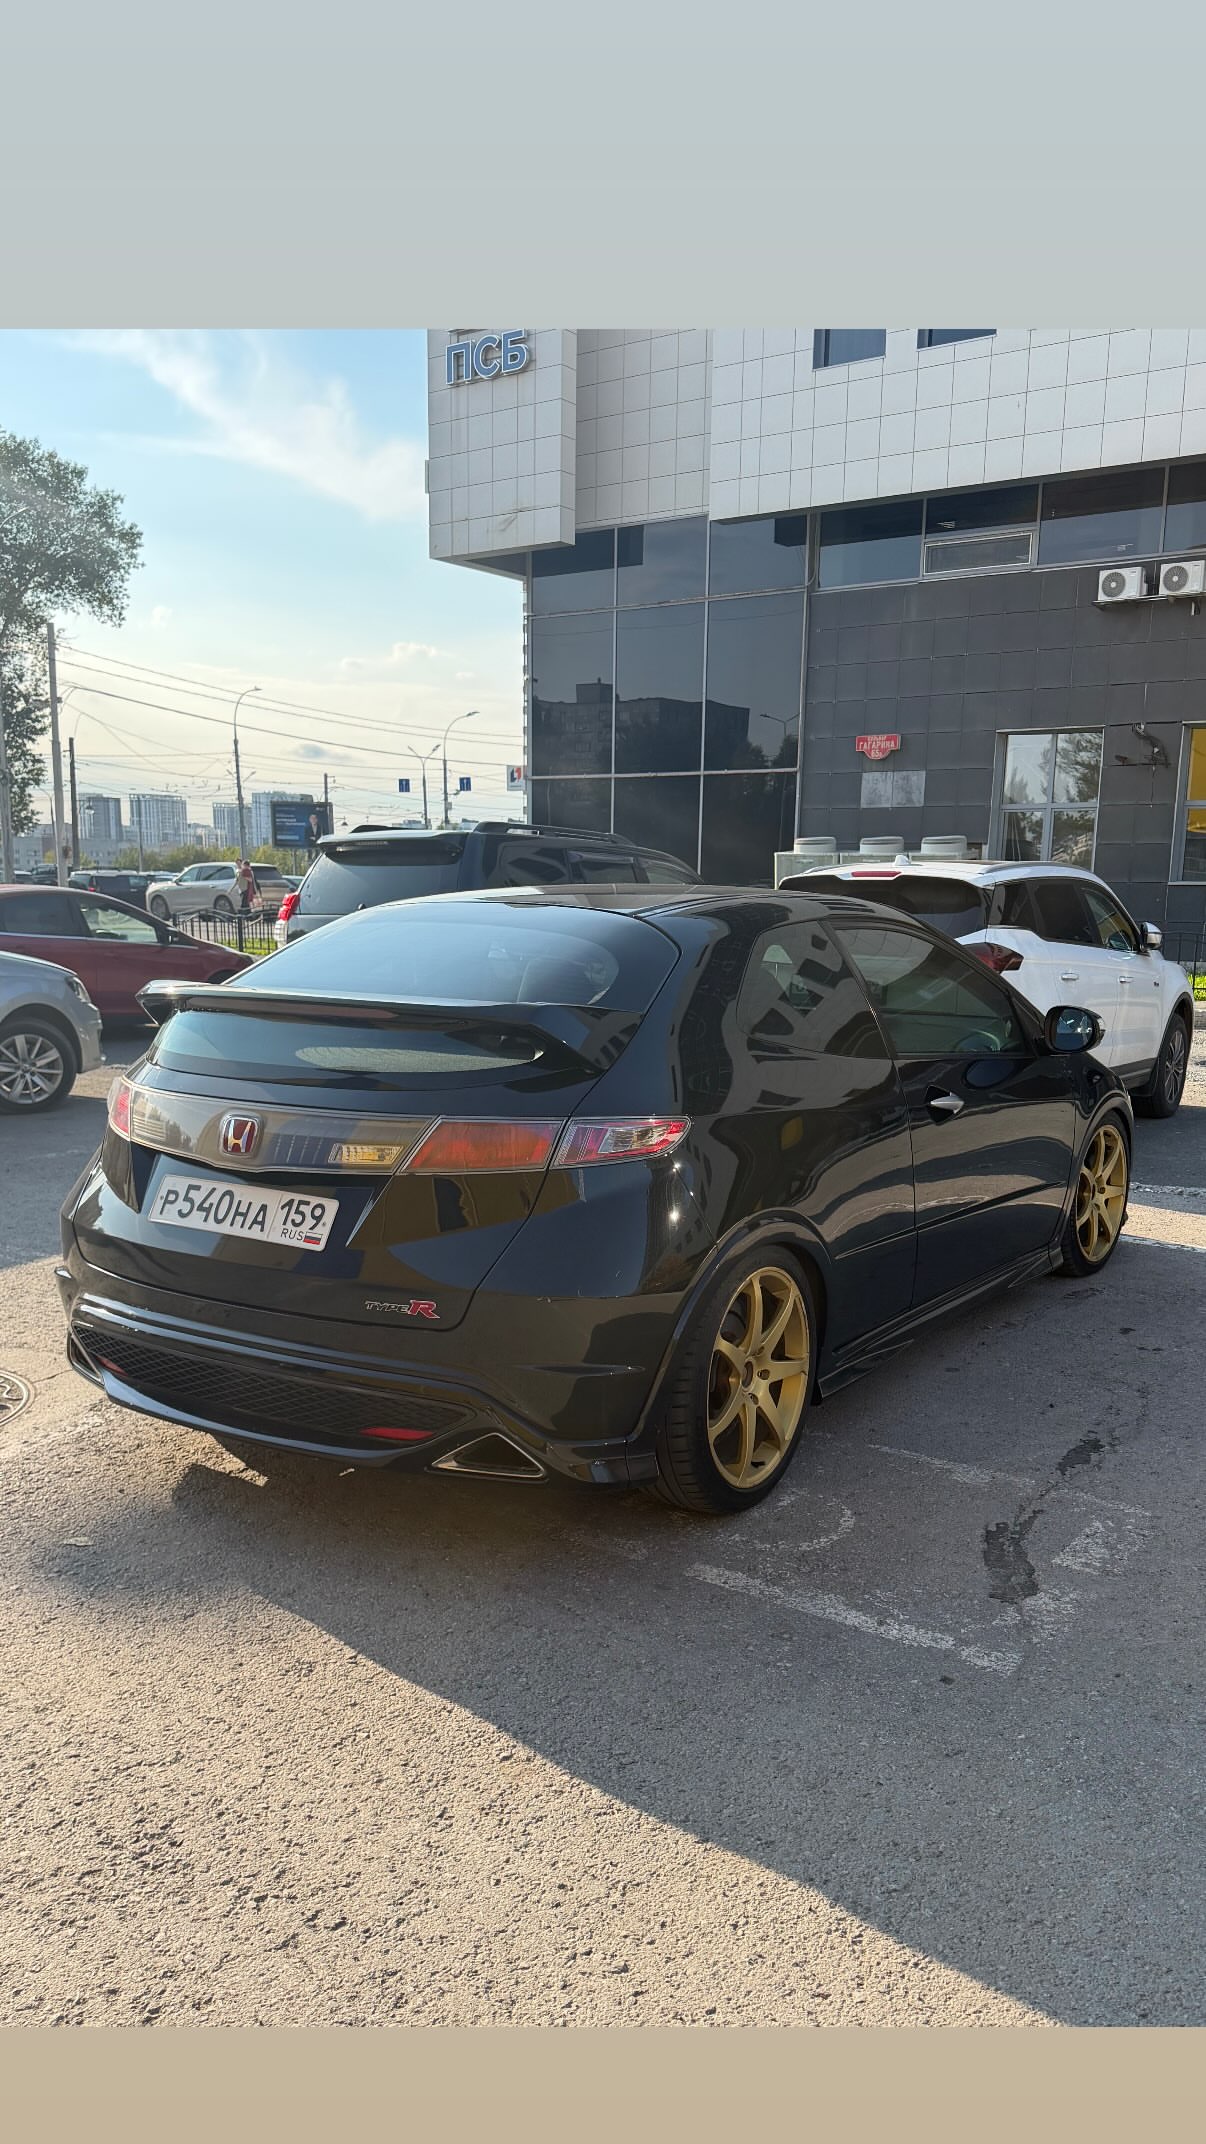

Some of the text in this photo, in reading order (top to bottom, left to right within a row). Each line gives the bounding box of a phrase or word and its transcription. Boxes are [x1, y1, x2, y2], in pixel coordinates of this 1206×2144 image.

[446, 328, 528, 385] ПСБ
[280, 1198, 326, 1231] 159
[280, 1228, 305, 1241] RUS
